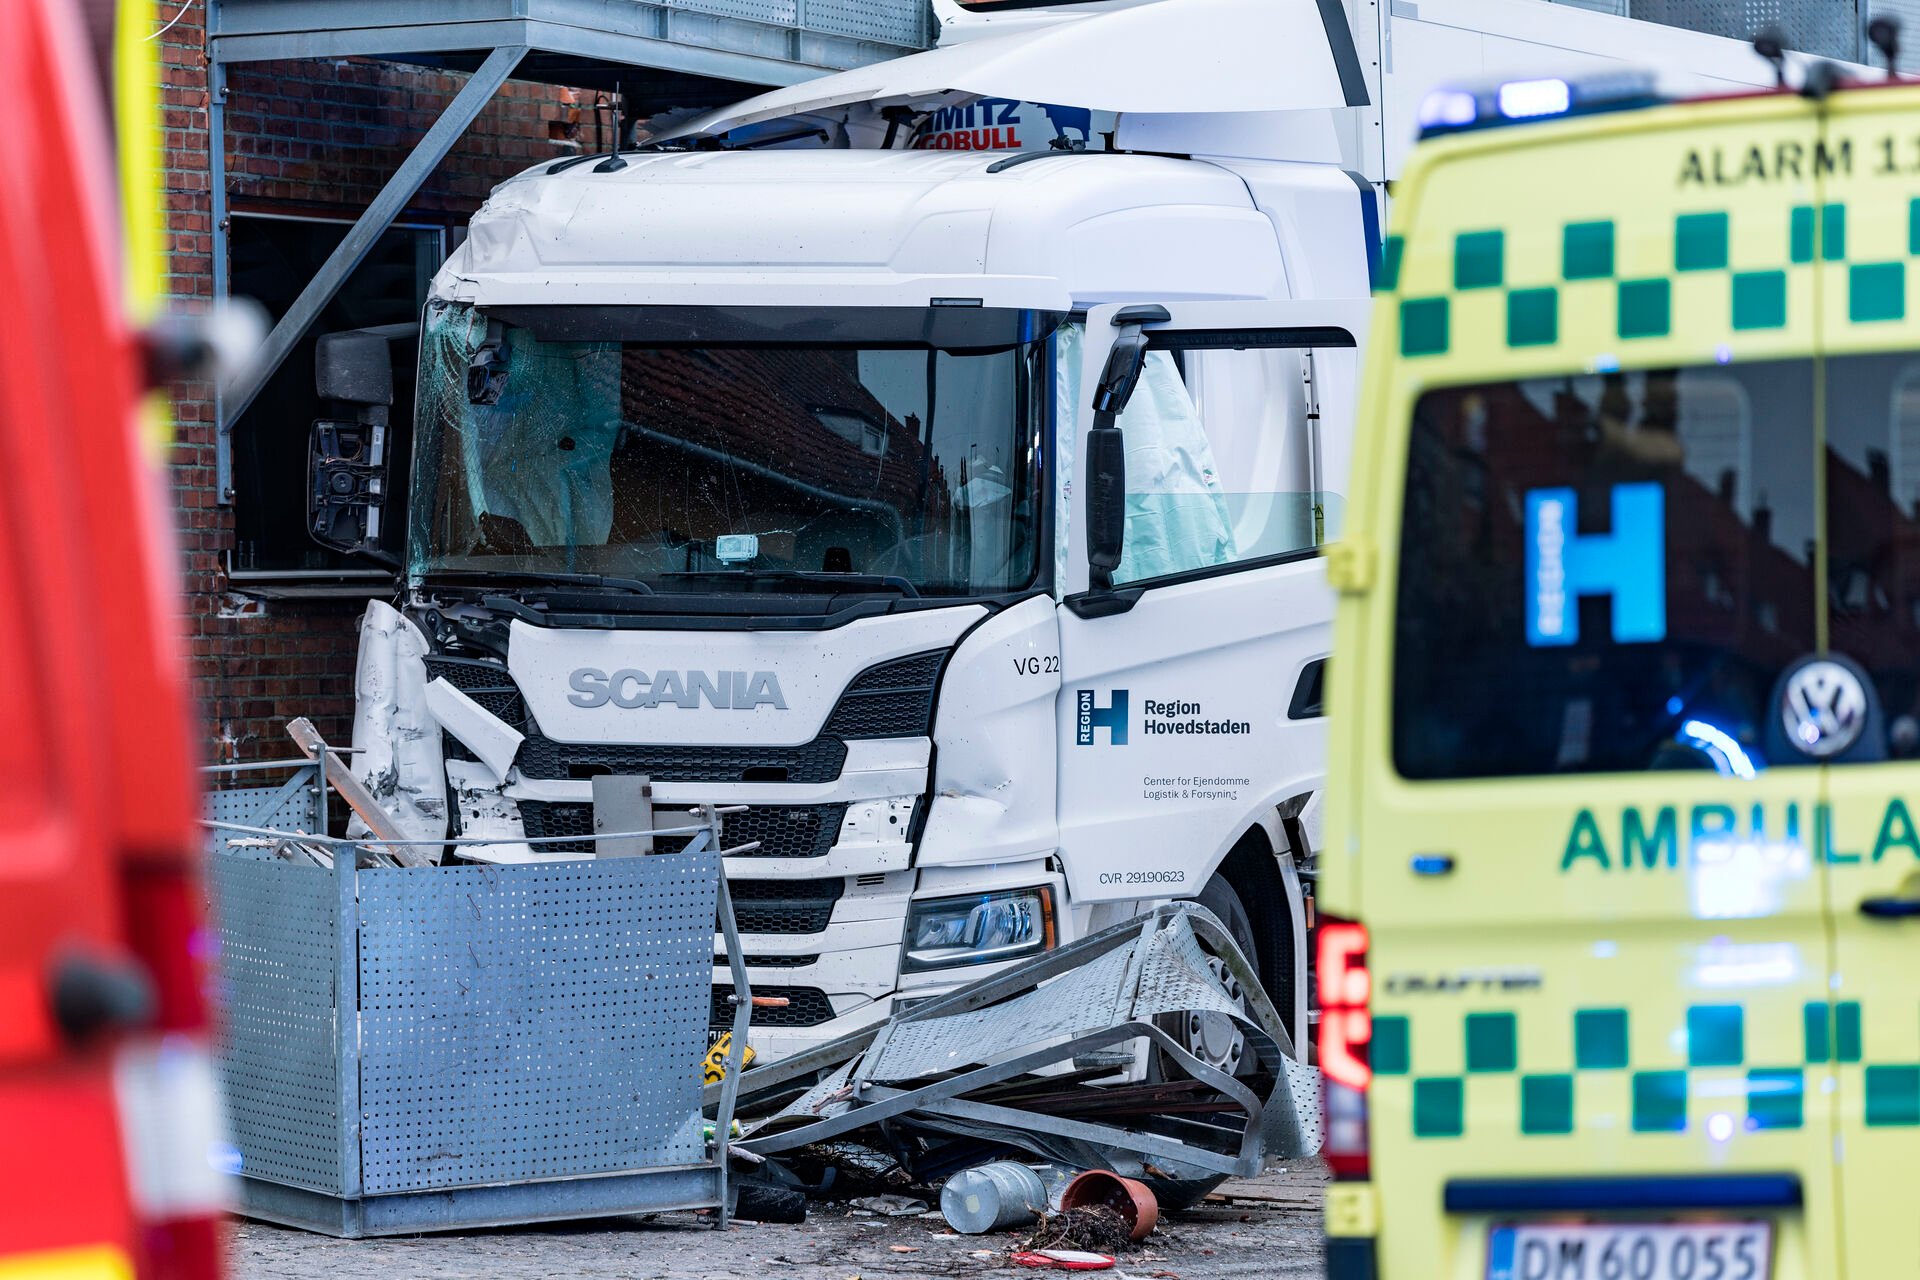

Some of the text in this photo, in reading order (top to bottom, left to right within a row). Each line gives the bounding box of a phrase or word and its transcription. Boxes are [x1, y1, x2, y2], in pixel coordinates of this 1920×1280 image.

[1677, 141, 1852, 187] ALARM
[1013, 655, 1060, 676] VG 22
[567, 667, 789, 710] SCANIA
[1080, 692, 1091, 743] REGION
[1144, 699, 1201, 719] Region
[1144, 719, 1251, 735] Hovedstaden
[1143, 775, 1250, 788] Center for Ejendomme
[1143, 789, 1180, 801] Logistik
[1182, 789, 1189, 799] &
[1099, 870, 1185, 885] CVR 29190623
[1599, 1236, 1657, 1280] 60
[1668, 1234, 1758, 1280] 055
